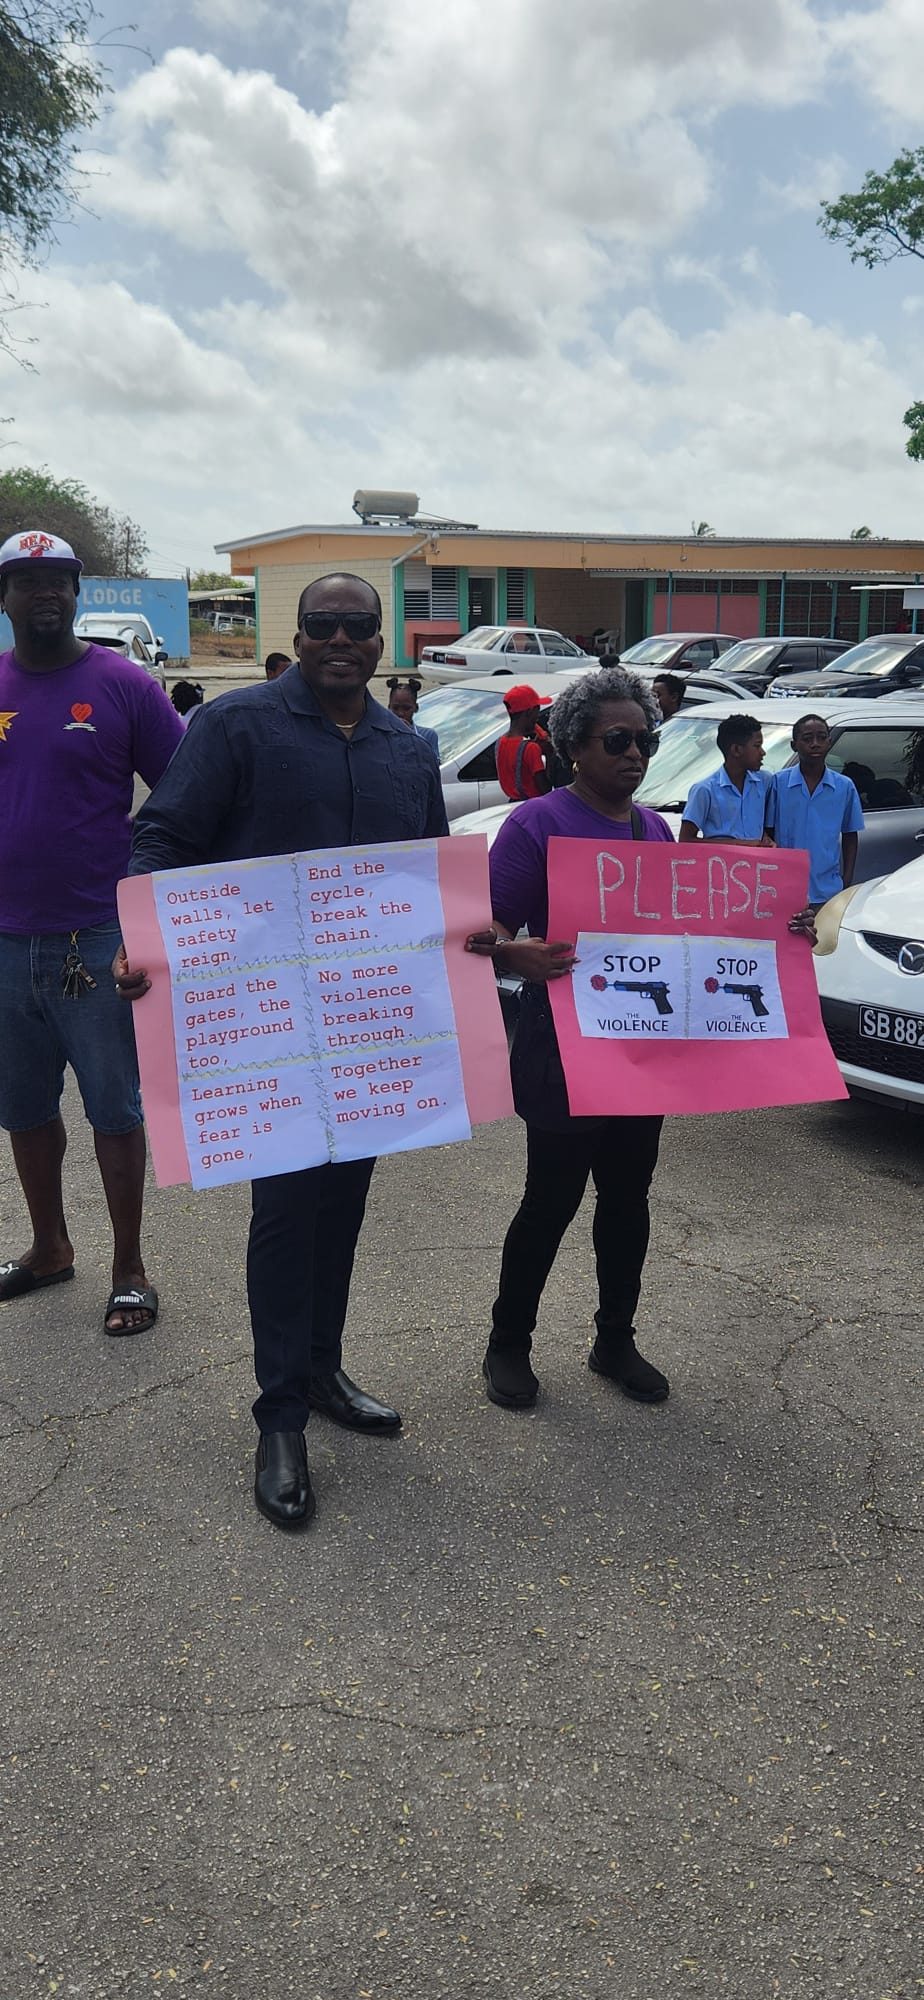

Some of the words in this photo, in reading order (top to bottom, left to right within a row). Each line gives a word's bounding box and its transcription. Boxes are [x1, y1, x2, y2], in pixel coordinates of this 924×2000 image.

[83, 588, 142, 605] LODGE
[308, 865, 342, 881] End
[353, 862, 385, 876] the
[167, 884, 241, 904] Outside
[310, 885, 373, 904] cycle,
[597, 852, 778, 924] PLEASE
[171, 909, 231, 926] walls,
[244, 900, 275, 914] let
[311, 906, 368, 923] break
[380, 902, 412, 915] the
[177, 928, 237, 947] safety
[315, 928, 379, 944] chain.
[181, 951, 237, 968] reign,
[603, 955, 661, 973] STOP
[717, 958, 758, 976] STOP
[318, 971, 342, 983] No
[352, 965, 398, 979] more
[185, 984, 236, 1004] Guard
[246, 979, 277, 993] the
[321, 985, 412, 1004] violence
[186, 1008, 244, 1029] gates,
[259, 999, 291, 1013] the
[323, 1006, 414, 1026] breaking
[863, 1010, 890, 1038] SB
[186, 1018, 294, 1051] playground
[597, 1019, 669, 1032] VIOLENCE
[706, 1020, 768, 1032] VIOLENCE
[327, 1026, 413, 1047] through.
[189, 1055, 228, 1069] too,
[331, 1056, 422, 1079] Together
[192, 1078, 278, 1101] Learning
[335, 1089, 357, 1101] we
[368, 1079, 414, 1095] keep
[195, 1105, 248, 1126] grows
[259, 1095, 302, 1111] when
[336, 1103, 405, 1123] moving
[417, 1097, 447, 1109] on.
[199, 1127, 240, 1144] fear
[253, 1122, 272, 1134] is
[201, 1149, 253, 1169] gone,
[114, 1295, 140, 1303] PUMA
